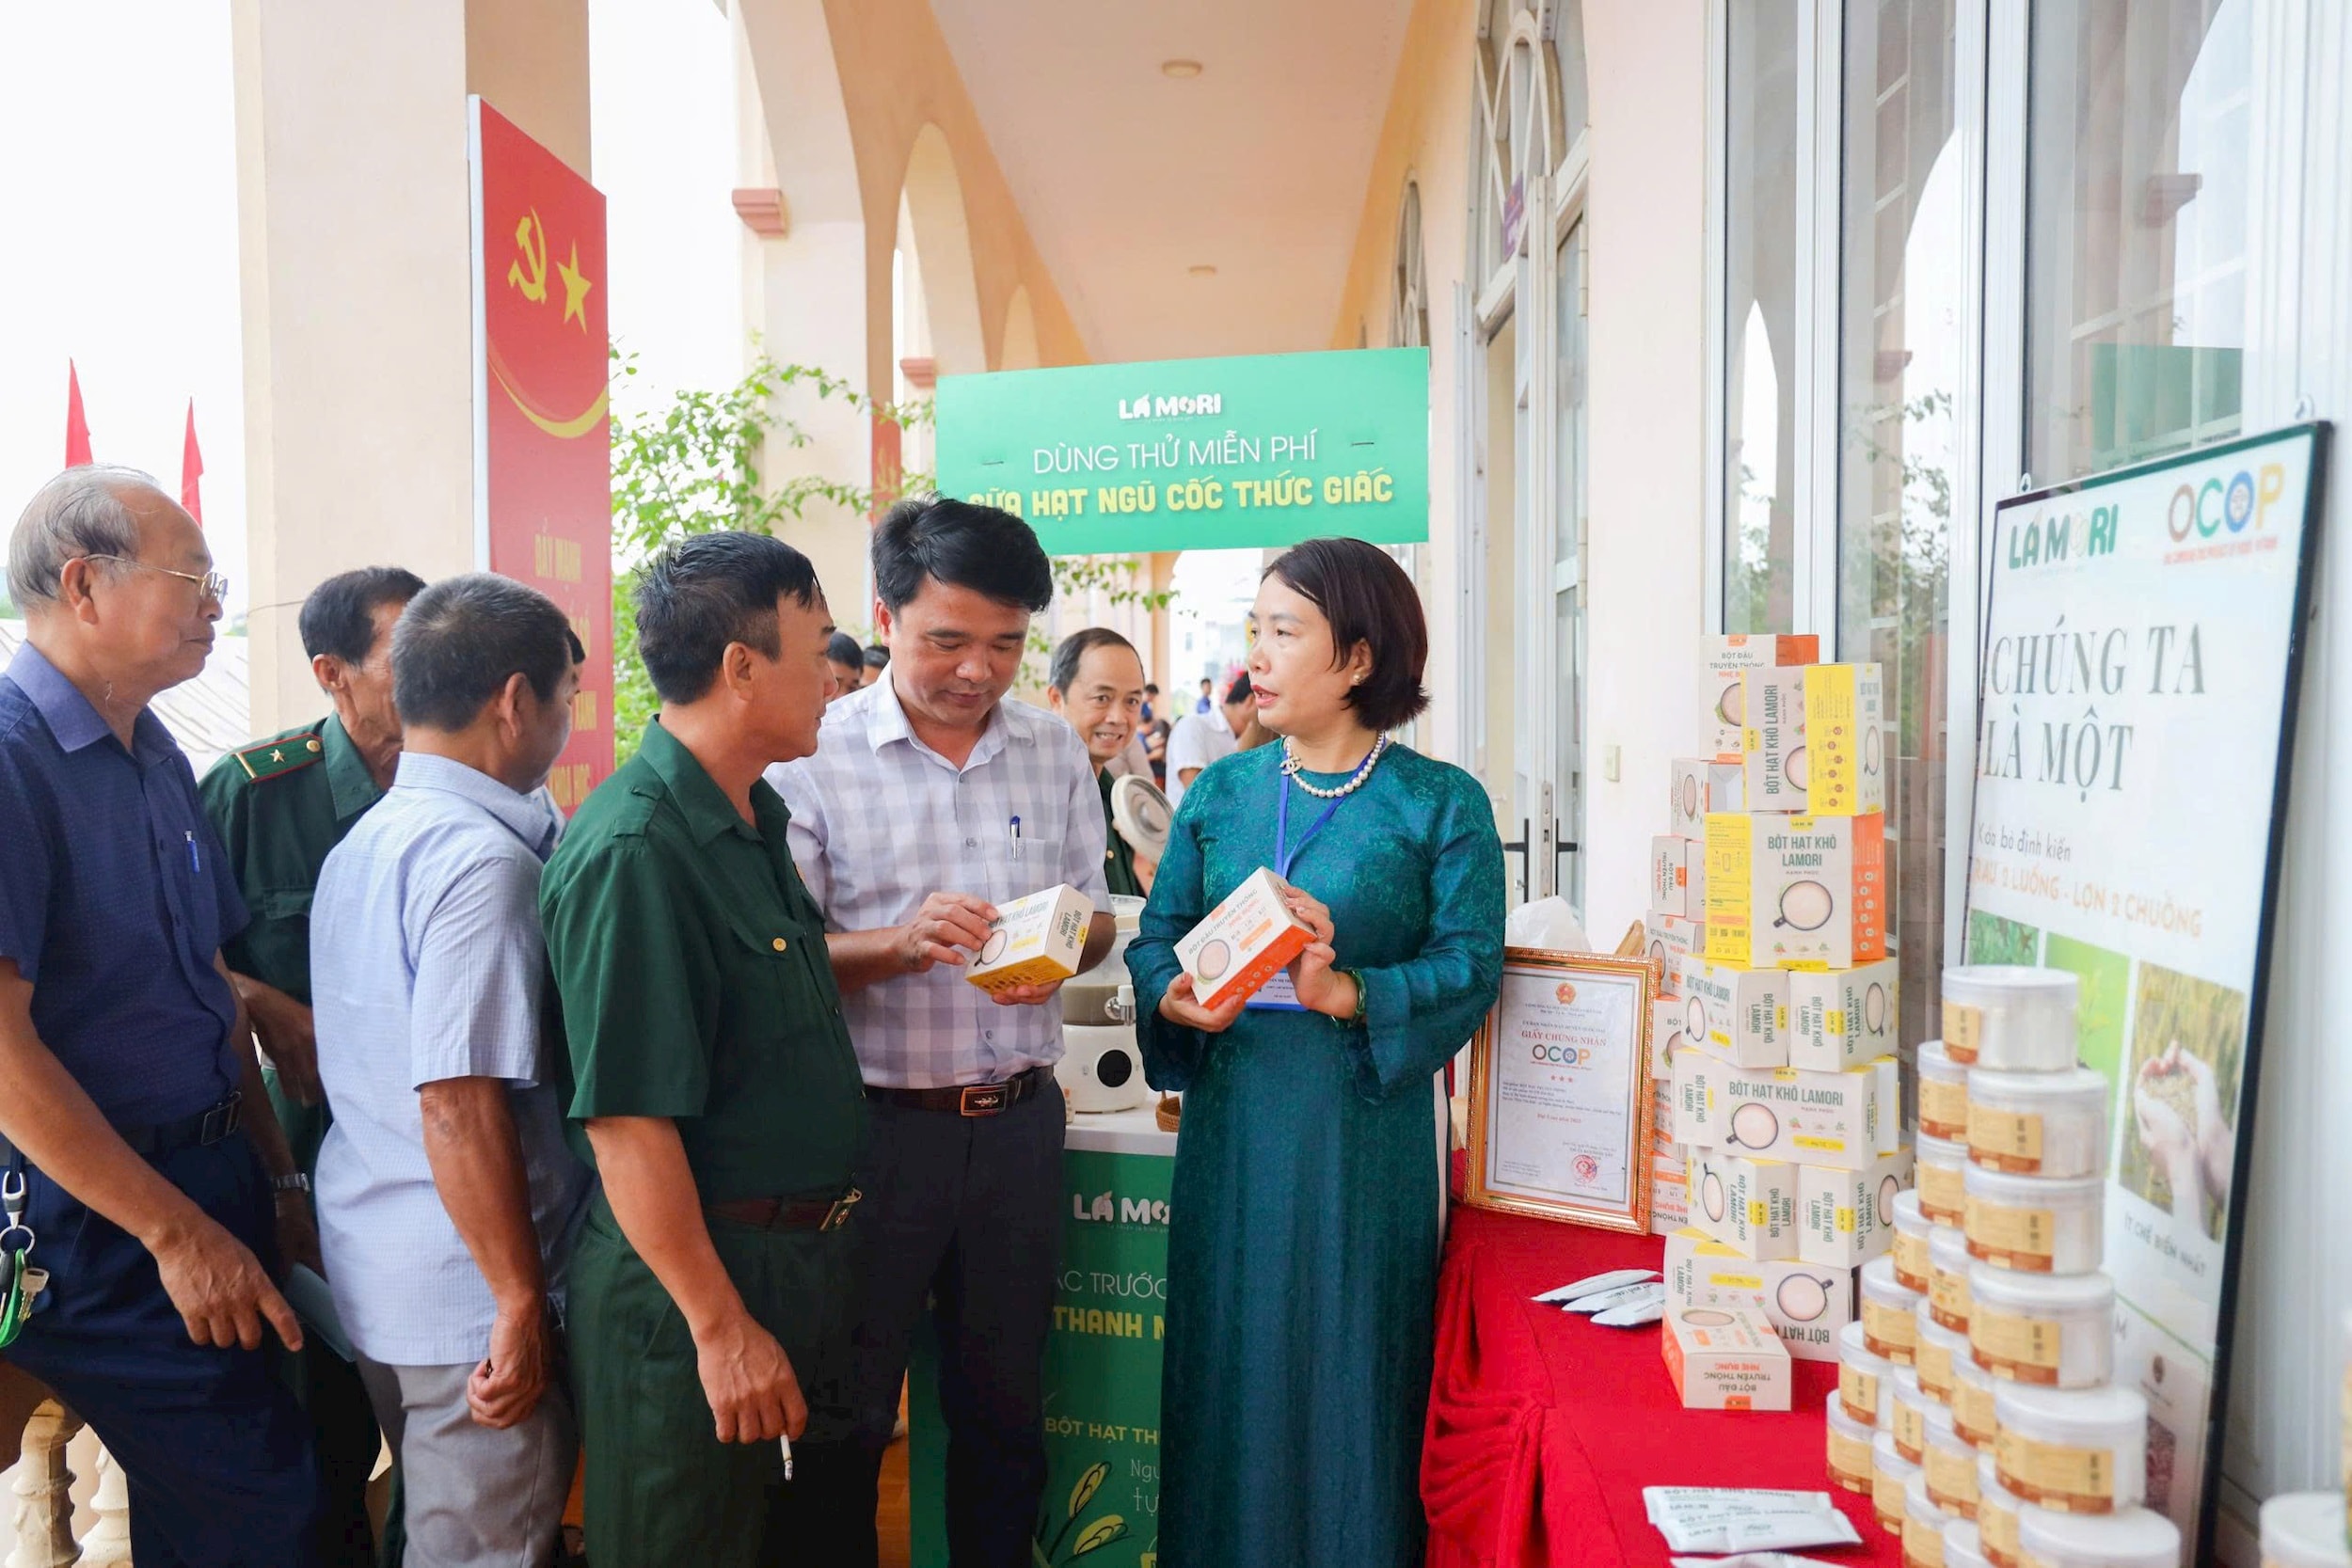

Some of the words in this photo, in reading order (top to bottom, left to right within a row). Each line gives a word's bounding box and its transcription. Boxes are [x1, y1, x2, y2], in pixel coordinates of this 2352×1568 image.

[1118, 393, 1151, 420] LÁ
[1155, 392, 1222, 419] MORI
[1033, 442, 1120, 474] DÙNG
[1126, 433, 1181, 469] THỬ
[1188, 430, 1261, 467] MIỄN
[1270, 428, 1318, 462] PHÍ
[1031, 487, 1089, 522] HẠT
[1098, 480, 1157, 514] NGŨ
[1166, 475, 1223, 511] CỐC
[1232, 469, 1313, 508] THỨC
[1323, 467, 1394, 504] GIẤC
[2167, 462, 2286, 544] OCOP
[2044, 503, 2120, 563] MORI
[1990, 614, 2128, 696] CHÚNG
[2147, 623, 2206, 695] TA
[1765, 685, 1778, 726] LAMORI
[1762, 729, 1779, 751] KHÔ
[1765, 752, 1781, 774] HẠT
[1983, 703, 2023, 780] LÀ
[2038, 704, 2135, 803] MỘT
[1763, 775, 1780, 795] BỘT
[1768, 834, 1788, 852] BỘT
[1790, 836, 1812, 853] HẠT
[1815, 833, 1837, 850] KHÔ
[1978, 822, 1996, 847] Xóa
[2000, 824, 2014, 850] bỏ
[2017, 828, 2042, 857] định
[2045, 832, 2072, 863] kiến
[1782, 853, 1822, 867] LAMORI
[2073, 881, 2106, 916] LỢN
[1763, 993, 1774, 1009] BỘT
[1751, 1004, 1761, 1034] LAMORI
[1762, 1011, 1773, 1026] HẠT
[1800, 1006, 1810, 1036] LAMORI
[1521, 1028, 1544, 1039] GIẤY
[1580, 1036, 1607, 1048] NHẬN
[1764, 1027, 1775, 1044] KHÔ
[1532, 1044, 1591, 1065] OCOP
[1695, 1074, 1707, 1089] BỘT
[1728, 1080, 1750, 1099] BỘT
[1751, 1083, 1774, 1101] HẠT
[1775, 1084, 1799, 1102] KHÔ
[1801, 1088, 1844, 1107] LAMORI
[1684, 1083, 1694, 1112] LAMORI
[1694, 1091, 1706, 1106] HẠT
[1695, 1107, 1707, 1123] KHÔ
[1073, 1191, 1114, 1223] LÁ
[1729, 1183, 1738, 1224] LAMORI
[1768, 1187, 1780, 1204] KHÔ
[1770, 1206, 1781, 1222] HẠT
[1781, 1196, 1792, 1227] LAMORI
[1810, 1199, 1821, 1230] LAMORI
[1769, 1223, 1781, 1239] BỘT
[1677, 1265, 1686, 1295] LAMORI
[1054, 1306, 1143, 1338] THANH
[1782, 1323, 1805, 1341] HẠT
[1807, 1328, 1830, 1345] BỘT
[1703, 1371, 1735, 1381] THỐNG
[1736, 1372, 1772, 1382] TRUYỀN
[1740, 1383, 1757, 1393] BỘT
[1044, 1416, 1084, 1438] BỘT
[1088, 1423, 1127, 1444] HẠT
